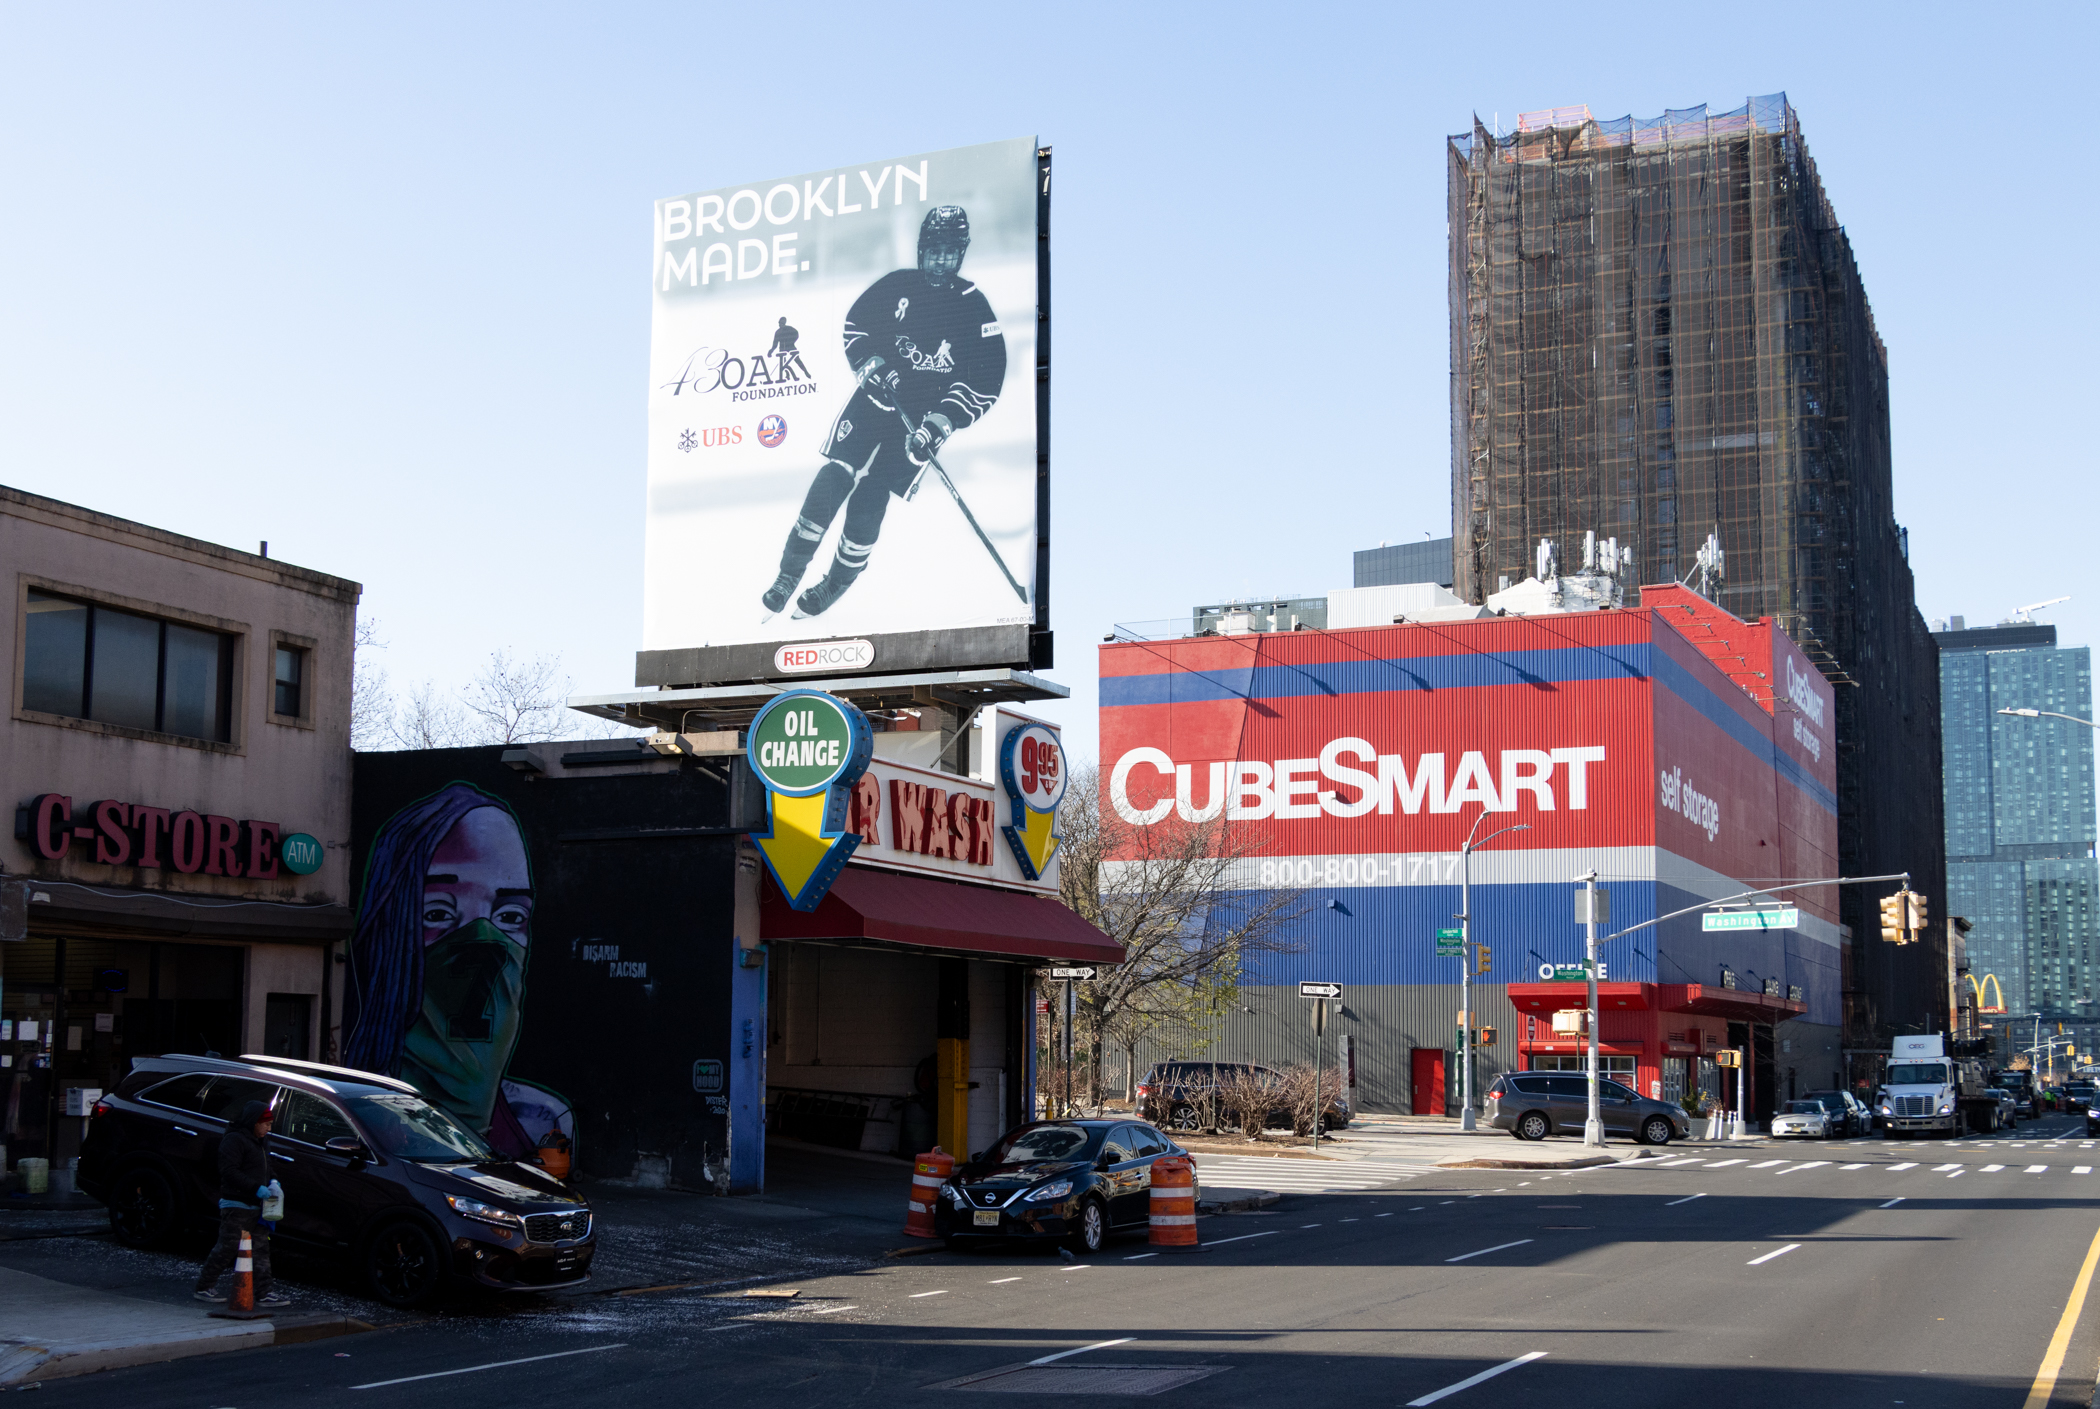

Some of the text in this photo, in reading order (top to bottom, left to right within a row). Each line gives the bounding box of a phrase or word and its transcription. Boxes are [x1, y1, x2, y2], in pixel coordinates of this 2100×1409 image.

[663, 160, 929, 242] BROOKLYN
[662, 233, 810, 291] MADE.
[731, 382, 818, 402] FOUNDATION
[703, 425, 743, 447] UBS
[783, 645, 866, 667] REDROCK
[784, 710, 818, 737] OIL
[1793, 717, 1821, 763] self storage
[760, 740, 840, 768] CHANGE
[1661, 765, 1719, 842] self storage
[889, 778, 995, 867] WASH
[32, 792, 280, 880] C-STORE
[286, 840, 316, 865] ATM
[1259, 855, 1461, 887] 800-800-1717
[1707, 916, 1777, 928] Washington
[582, 944, 620, 962] DISARM
[609, 961, 648, 978] RACISM
[1056, 968, 1091, 976] ONE WAY
[1306, 986, 1318, 994] ONE
[696, 1074, 720, 1088] HOOD
[708, 1064, 720, 1075] MY
